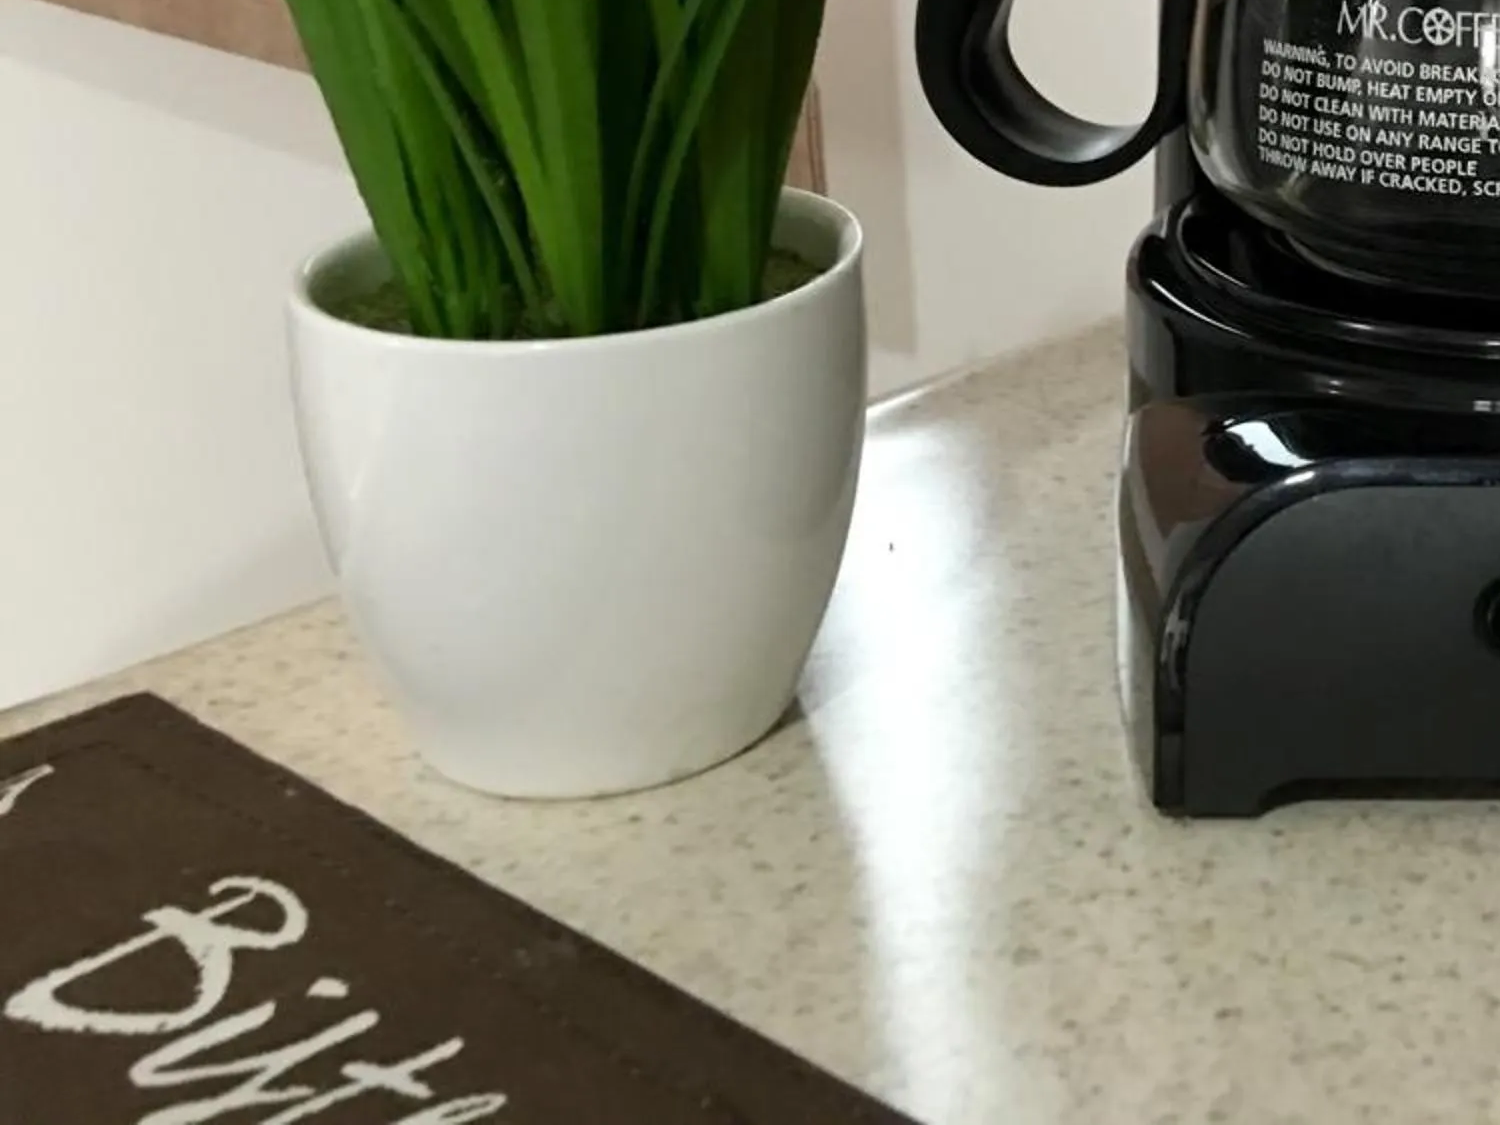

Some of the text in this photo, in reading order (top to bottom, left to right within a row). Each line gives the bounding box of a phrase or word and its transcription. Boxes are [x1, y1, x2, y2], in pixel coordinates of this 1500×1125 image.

[1261, 60, 1281, 78] DO
[1284, 64, 1313, 86] NOT
[1367, 79, 1412, 101] HEAT
[1415, 85, 1478, 106] EMPTY
[1335, 52, 1358, 71] TO
[1361, 56, 1415, 79] AVOID
[1259, 82, 1279, 102] DO
[1281, 88, 1311, 110] NOT
[1313, 96, 1364, 119] CLEAN
[1368, 103, 1413, 125] WITH
[1257, 126, 1478, 176] DO NOT HOLD OVER PEOPLE
[1258, 104, 1278, 124] DO
[1280, 110, 1311, 132] NOT
[1313, 118, 1342, 138] USE
[1345, 124, 1372, 143] ON
[1375, 128, 1414, 149] ANY
[1418, 133, 1482, 155] RANGE
[1257, 144, 1308, 173] THROW
[1310, 160, 1358, 182] AWAY
[1360, 167, 1376, 185] IF
[1379, 171, 1467, 197] CRACKED,
